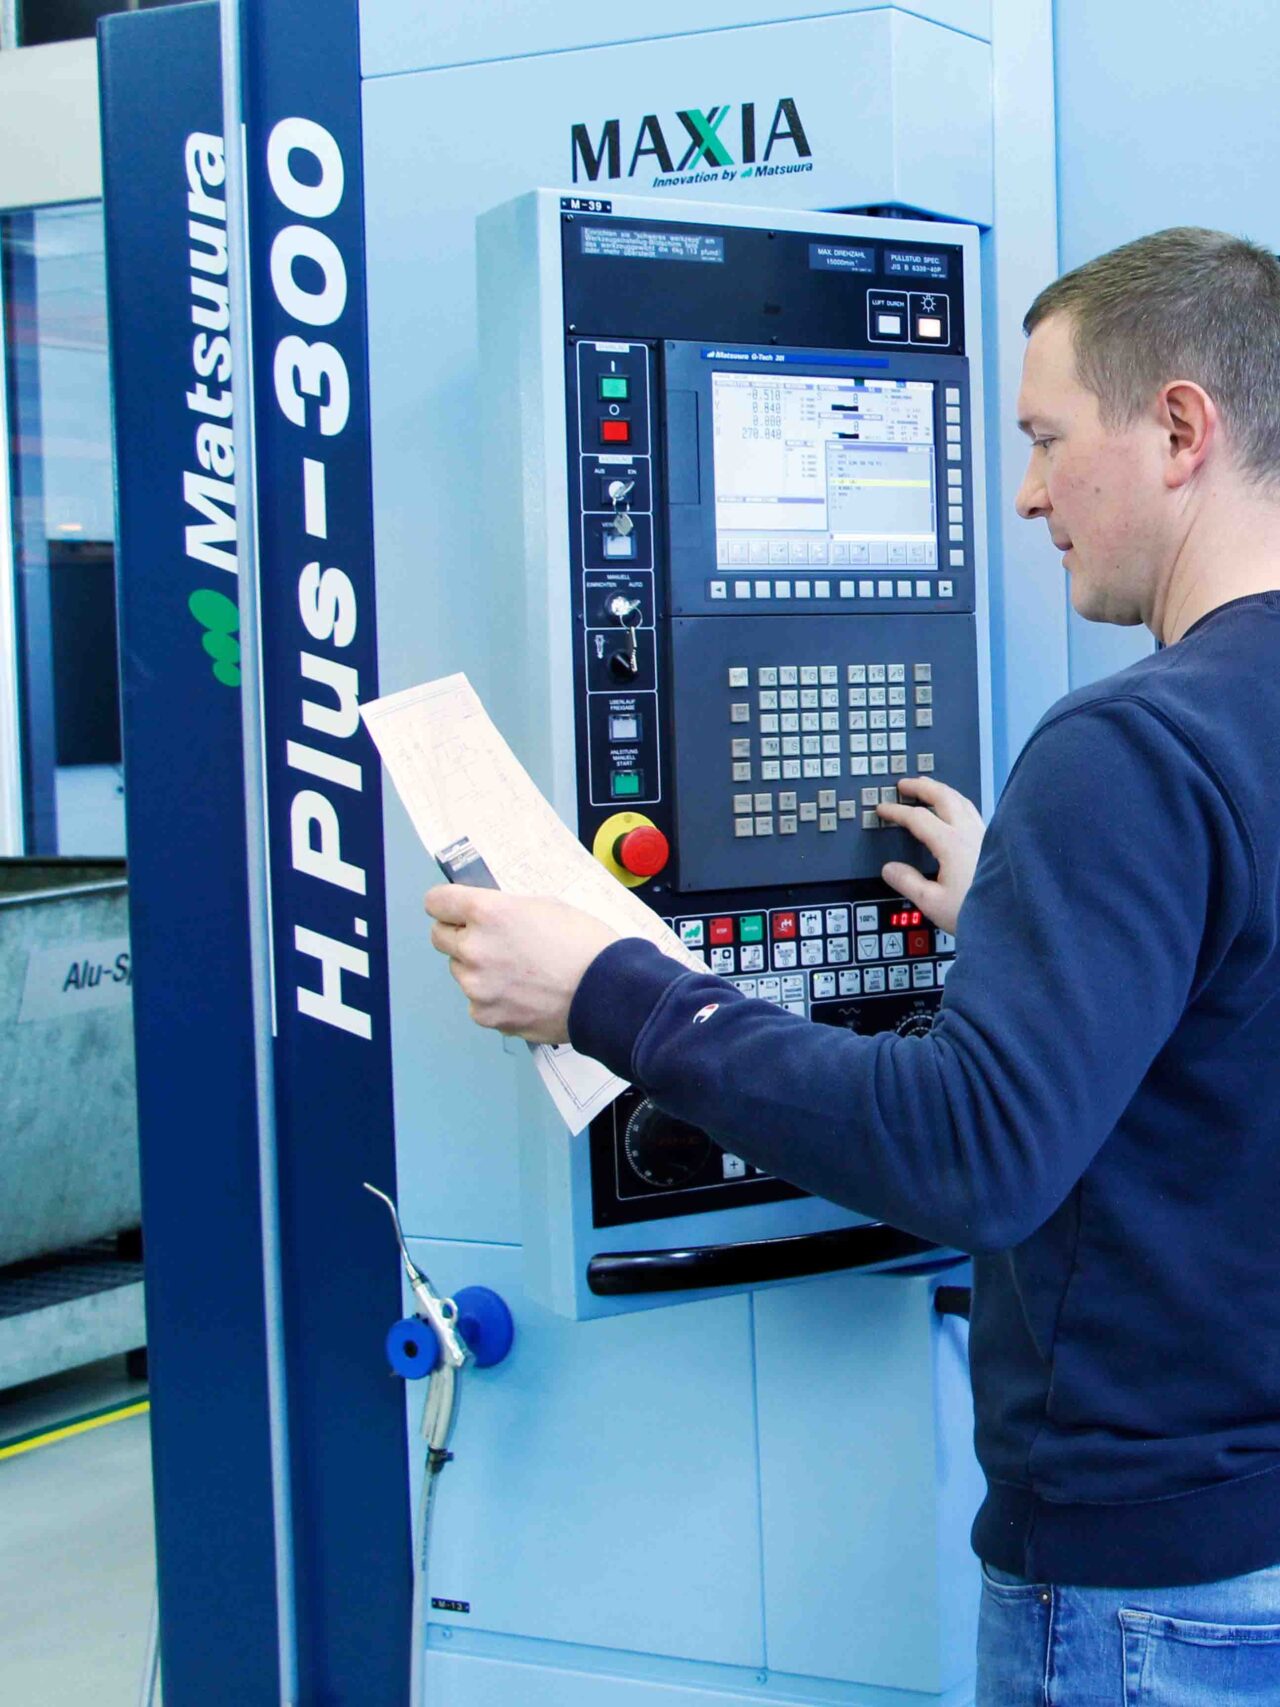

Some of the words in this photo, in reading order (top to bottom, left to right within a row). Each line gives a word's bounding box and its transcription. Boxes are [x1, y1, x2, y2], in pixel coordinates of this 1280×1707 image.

[571, 97, 812, 184] MAXIA
[652, 171, 718, 189] Innovation
[721, 169, 738, 181] by
[754, 162, 813, 178] Matsuura
[570, 199, 603, 212] M-39
[183, 132, 239, 574] Matsuura
[859, 914, 876, 923] 100%
[891, 912, 921, 926] 100
[62, 952, 131, 993] Alu-S
